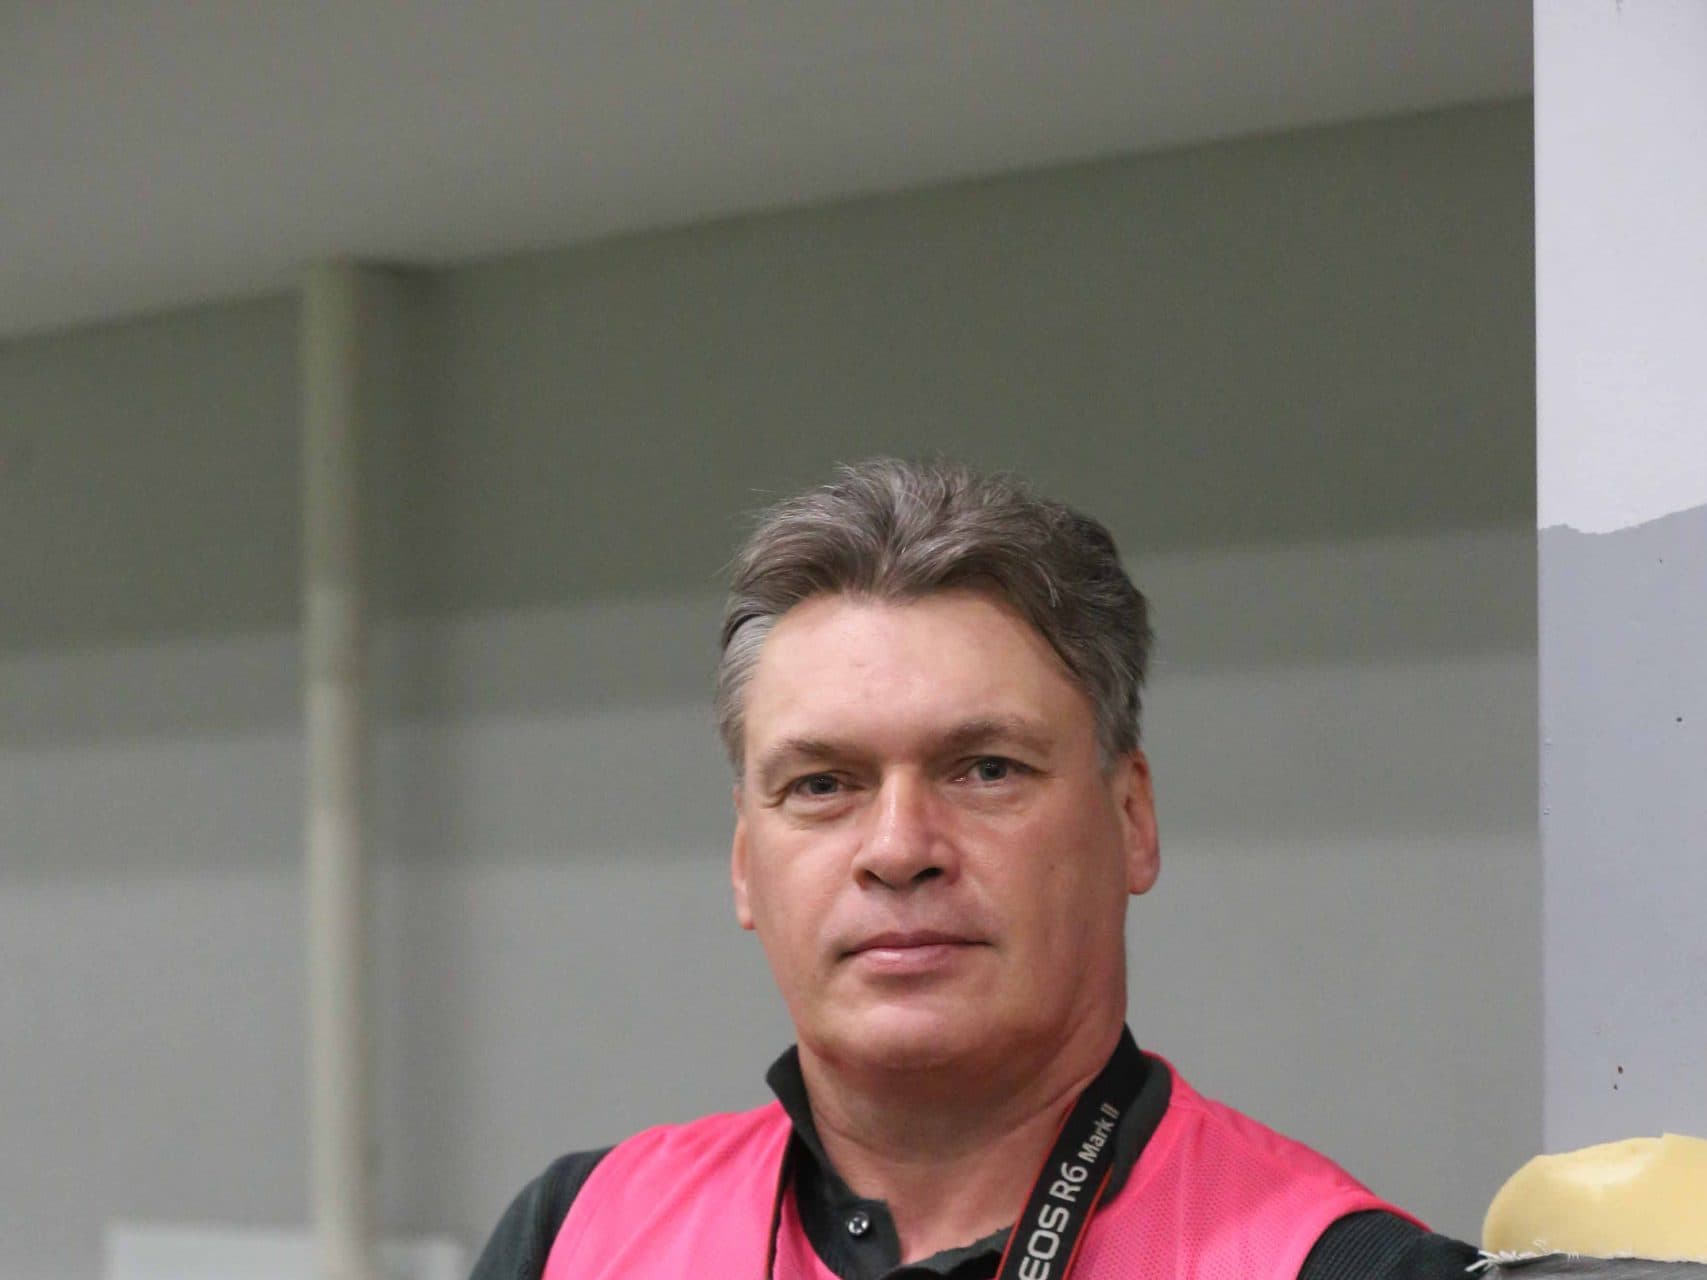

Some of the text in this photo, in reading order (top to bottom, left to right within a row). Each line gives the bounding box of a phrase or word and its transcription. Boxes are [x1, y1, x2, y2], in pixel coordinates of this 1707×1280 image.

[1049, 1162, 1088, 1202] R6
[1078, 1119, 1115, 1163] Mark
[1101, 1103, 1120, 1119] II
